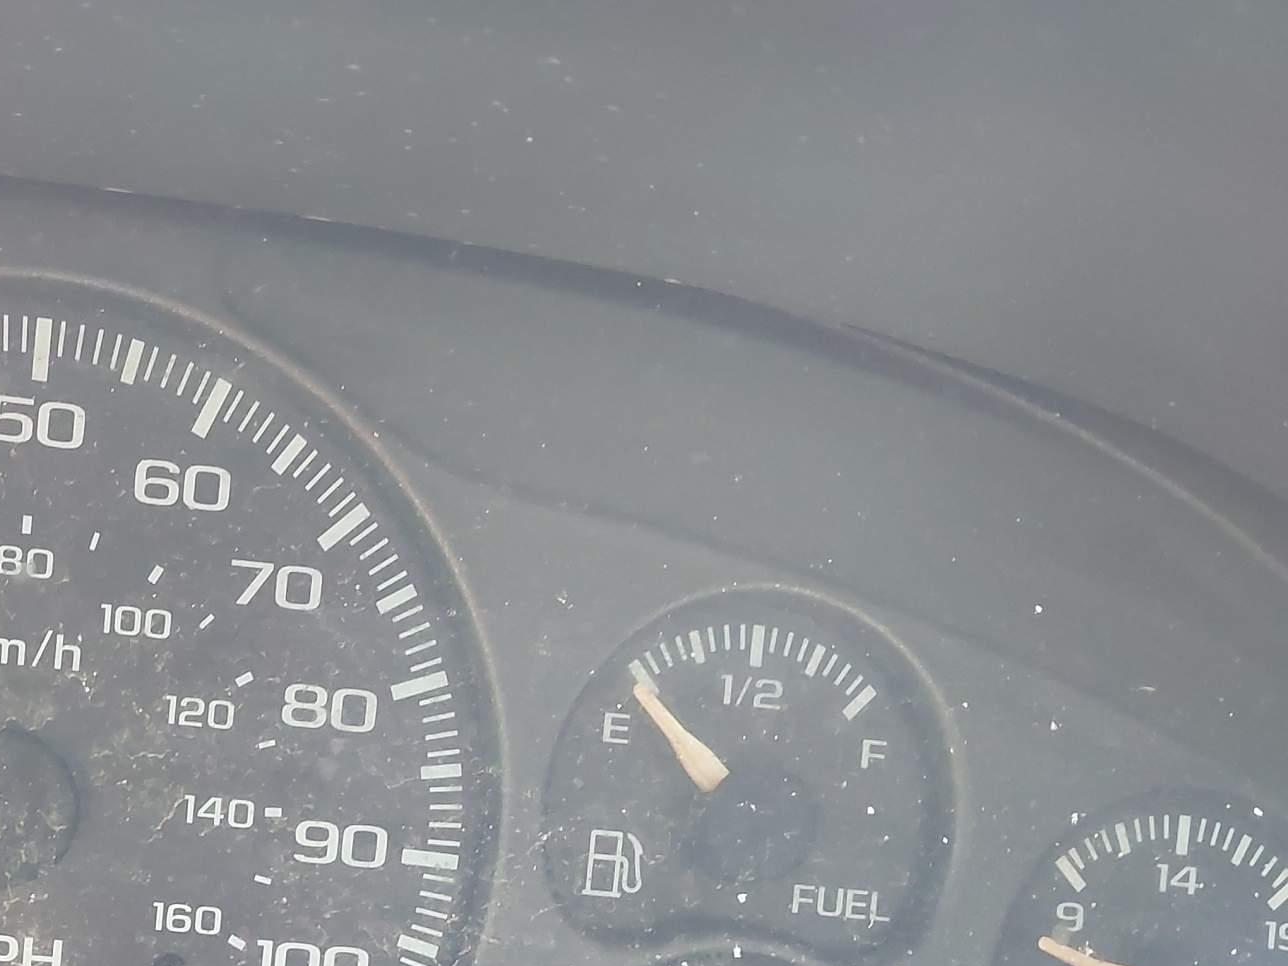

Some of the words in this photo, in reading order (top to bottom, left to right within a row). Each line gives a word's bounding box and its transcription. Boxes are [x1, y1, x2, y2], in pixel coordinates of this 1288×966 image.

[134, 459, 231, 512] 60
[231, 559, 323, 611] 70
[100, 603, 171, 640] 100
[281, 683, 378, 733] 80
[721, 673, 784, 710] 1/2
[166, 695, 235, 729] 120
[602, 712, 631, 744] E
[860, 739, 887, 769] F
[184, 795, 254, 828] 140
[294, 820, 388, 869] 90
[1157, 863, 1199, 895] 14
[153, 902, 222, 935] 160
[791, 884, 890, 923] FUEL
[1056, 902, 1084, 932] 9
